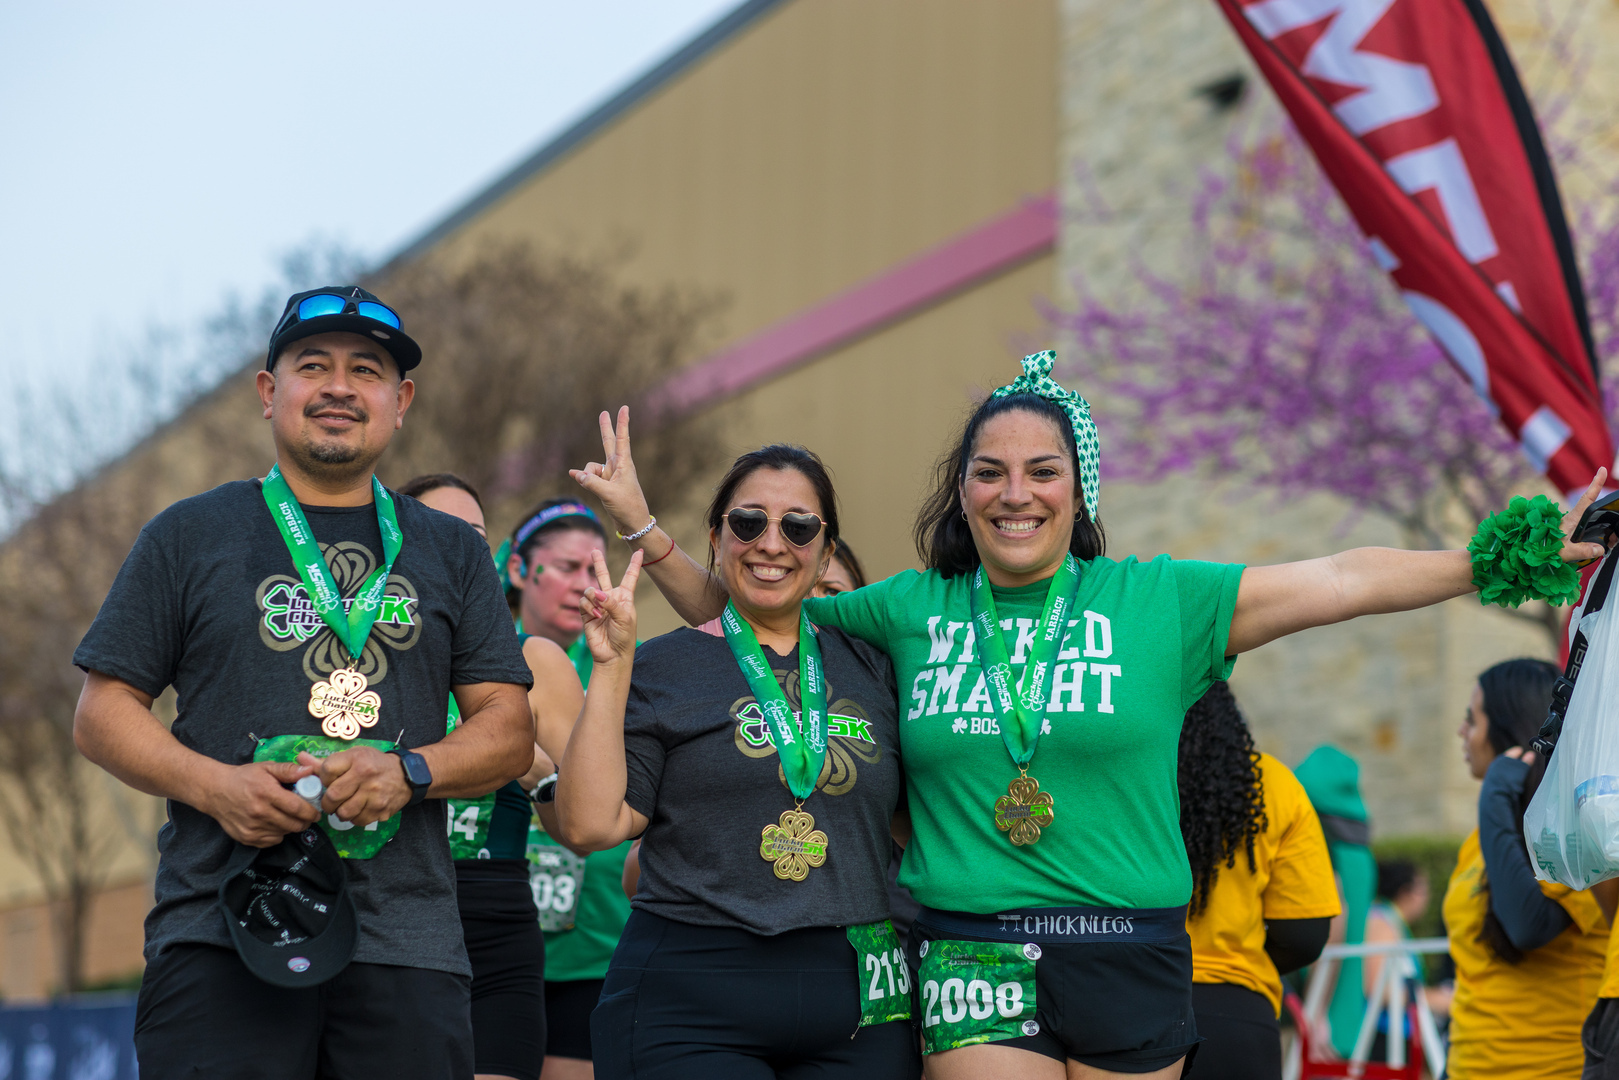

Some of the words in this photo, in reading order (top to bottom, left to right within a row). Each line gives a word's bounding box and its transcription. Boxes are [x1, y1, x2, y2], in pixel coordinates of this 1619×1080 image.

[279, 501, 306, 546] KARBACH
[977, 611, 995, 640] Holiday
[1044, 596, 1065, 641] KARBACH
[926, 610, 1113, 665] WIKED
[742, 653, 767, 680] Holiday
[807, 654, 817, 695] KARBACH
[1033, 660, 1047, 680] 5K
[907, 661, 1122, 722] SMAHT
[1001, 692, 1014, 714] 5K
[322, 700, 355, 712] Charm
[324, 693, 355, 706] Lucky
[354, 702, 377, 715] 5K
[780, 725, 796, 746] 5K
[1030, 804, 1050, 816] 5K
[803, 842, 826, 856] 5K
[1024, 914, 1134, 935] CHICKNLEGS
[923, 978, 1024, 1028] 2008
